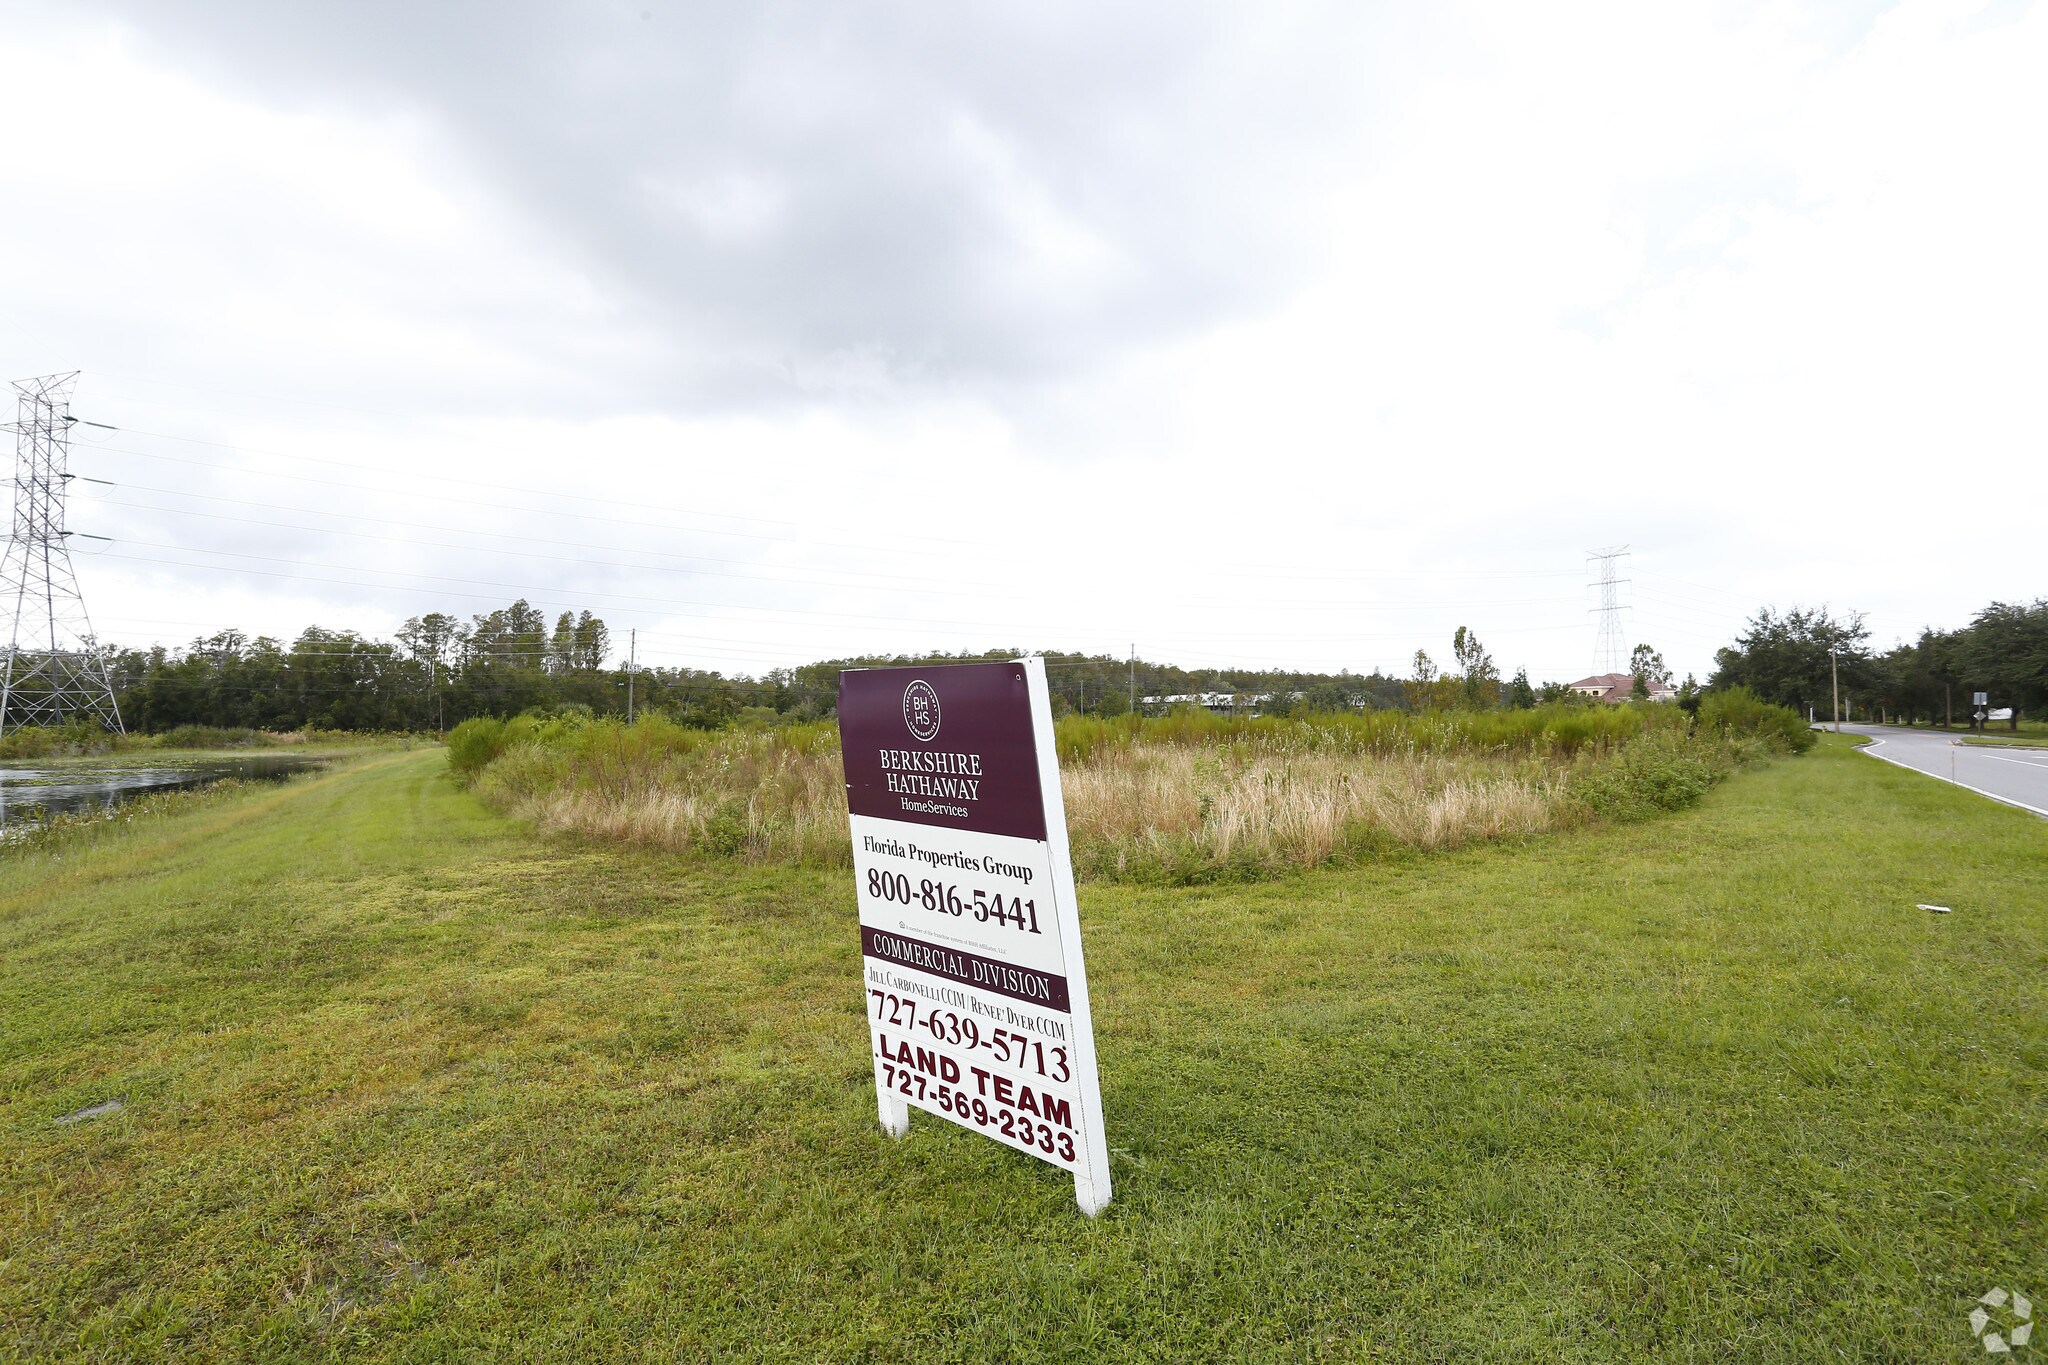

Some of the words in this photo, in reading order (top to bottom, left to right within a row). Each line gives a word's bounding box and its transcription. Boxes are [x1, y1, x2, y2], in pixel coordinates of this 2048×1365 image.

[913, 696, 928, 710] BH
[915, 711, 930, 724] HS
[879, 749, 982, 776] BERKSHIRE
[887, 773, 979, 801] HATHAWAY
[901, 797, 968, 818] HomeServices
[864, 835, 906, 859] Florida
[909, 843, 980, 872] Properties
[983, 855, 1033, 885] Group
[868, 868, 1042, 934] 800-816-5441
[873, 933, 968, 978] COMMERCIAL
[972, 959, 1051, 1001] DIVISION
[869, 966, 886, 985] JILL
[941, 986, 966, 1010] CCIM
[1006, 1007, 1035, 1032] DYER
[1036, 1016, 1065, 1041] CCIM
[872, 989, 1070, 1083] 727-639-5713
[880, 1034, 961, 1084] LAND
[971, 1066, 1073, 1130] TEAM
[883, 1063, 1076, 1162] 727-569-2333
